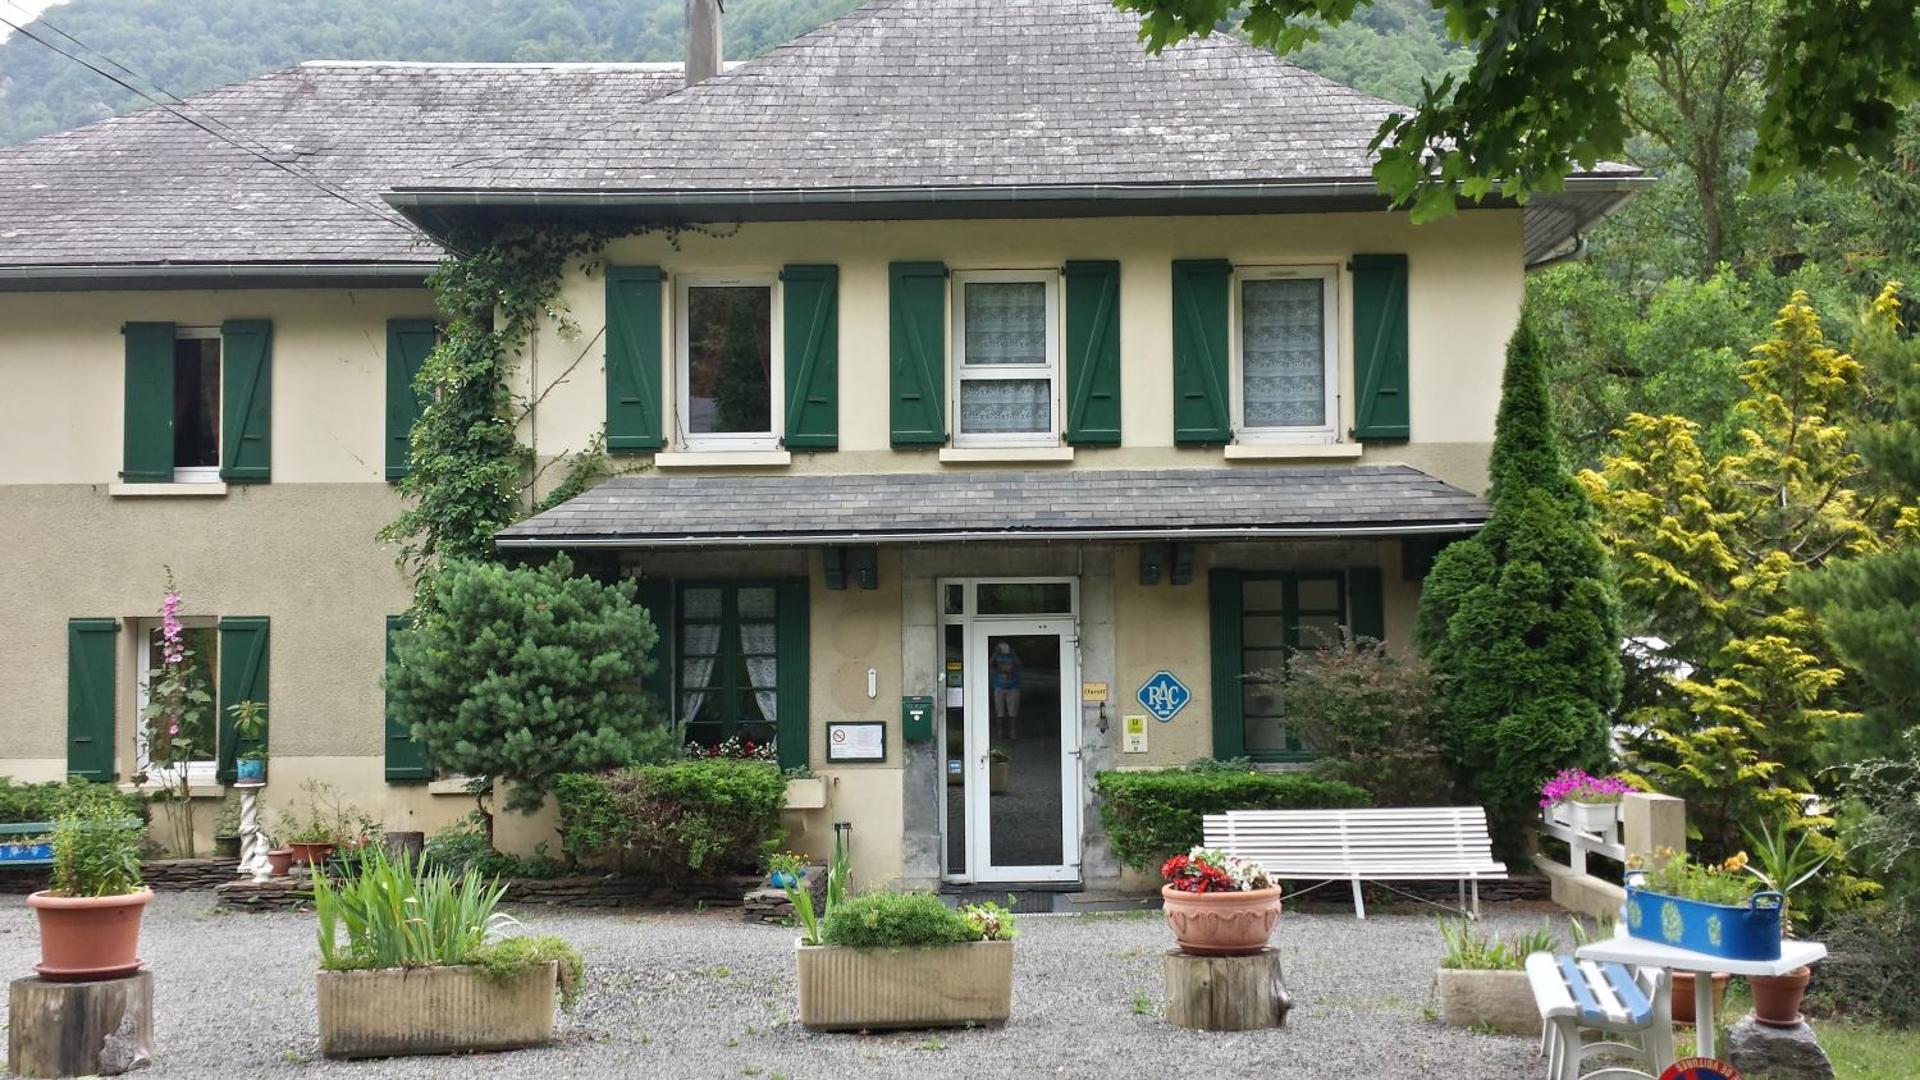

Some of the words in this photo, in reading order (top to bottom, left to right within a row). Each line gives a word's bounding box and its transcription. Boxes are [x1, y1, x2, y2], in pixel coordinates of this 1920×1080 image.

[1148, 680, 1179, 709] RAC
[1676, 1059, 1720, 1072] VOITURES
[1720, 1065, 1734, 1077] DE
